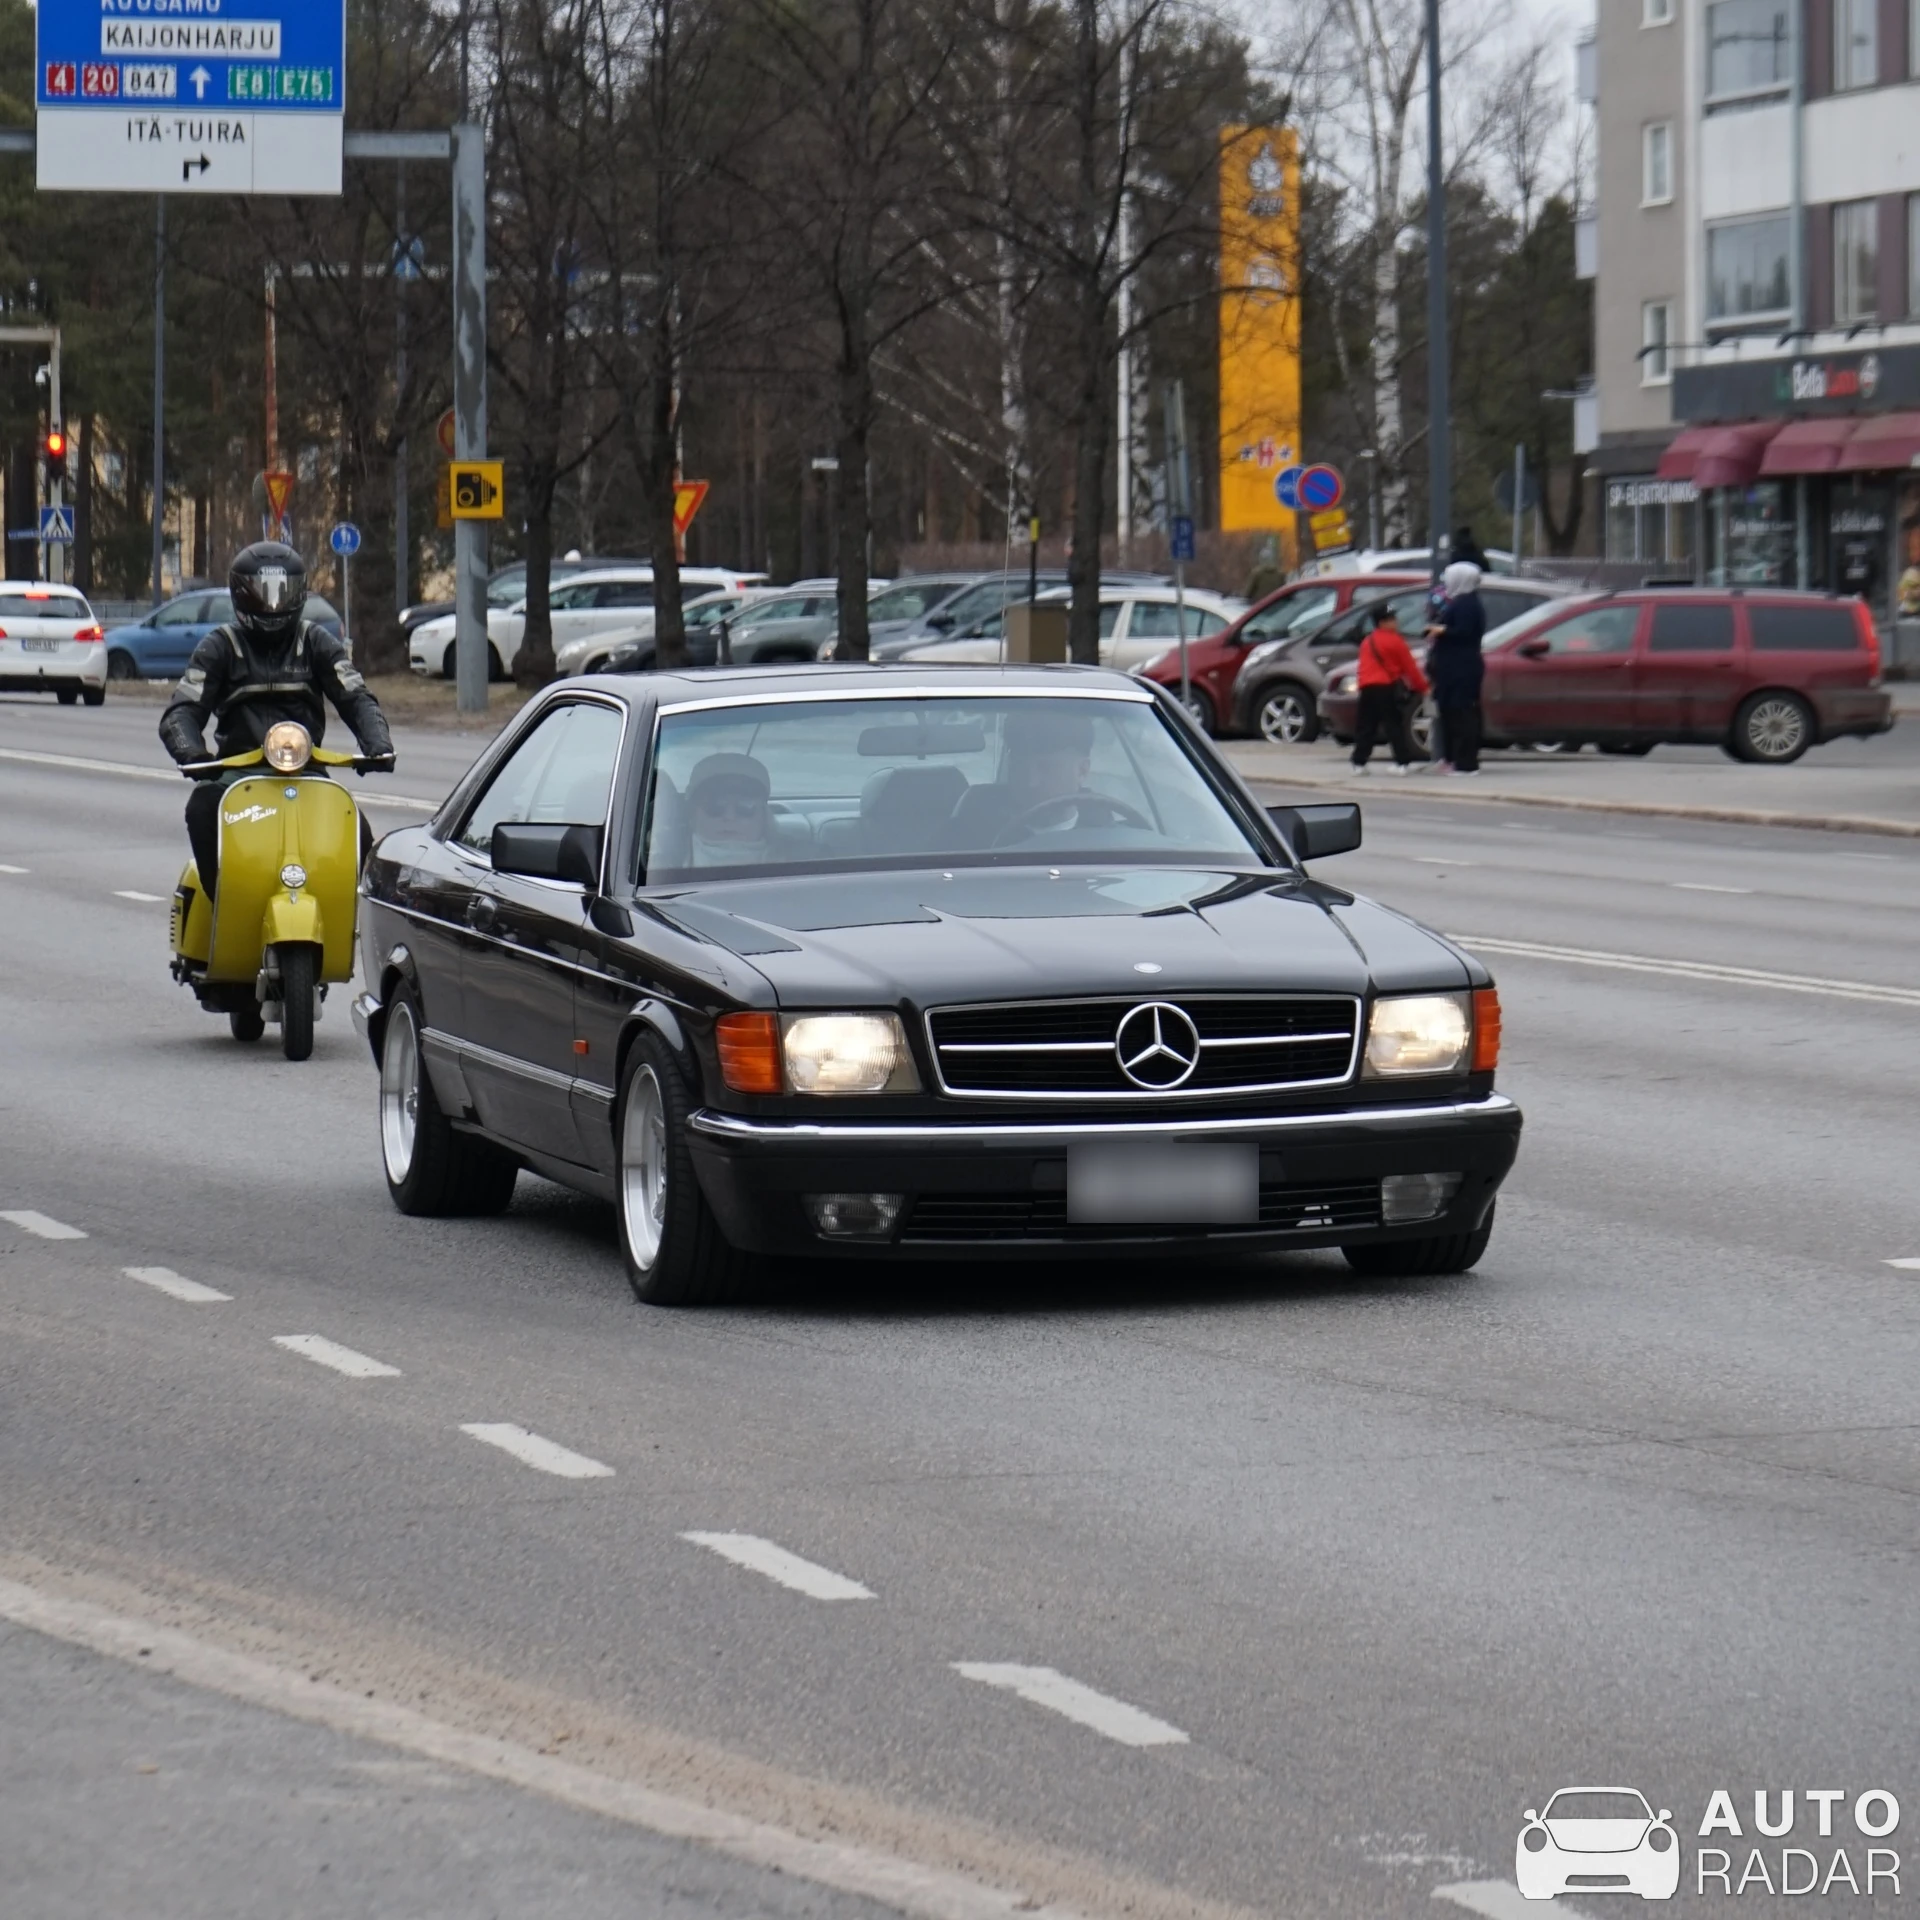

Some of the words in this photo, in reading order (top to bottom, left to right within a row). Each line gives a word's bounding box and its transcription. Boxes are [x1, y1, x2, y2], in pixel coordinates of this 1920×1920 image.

[106, 25, 275, 50] KAIJONHARJU
[54, 66, 67, 91] 4
[87, 66, 114, 92] 20
[130, 70, 168, 92] 847
[236, 69, 263, 95] E8
[283, 70, 323, 97] E75
[127, 115, 245, 143] ITÄ-TUIRA
